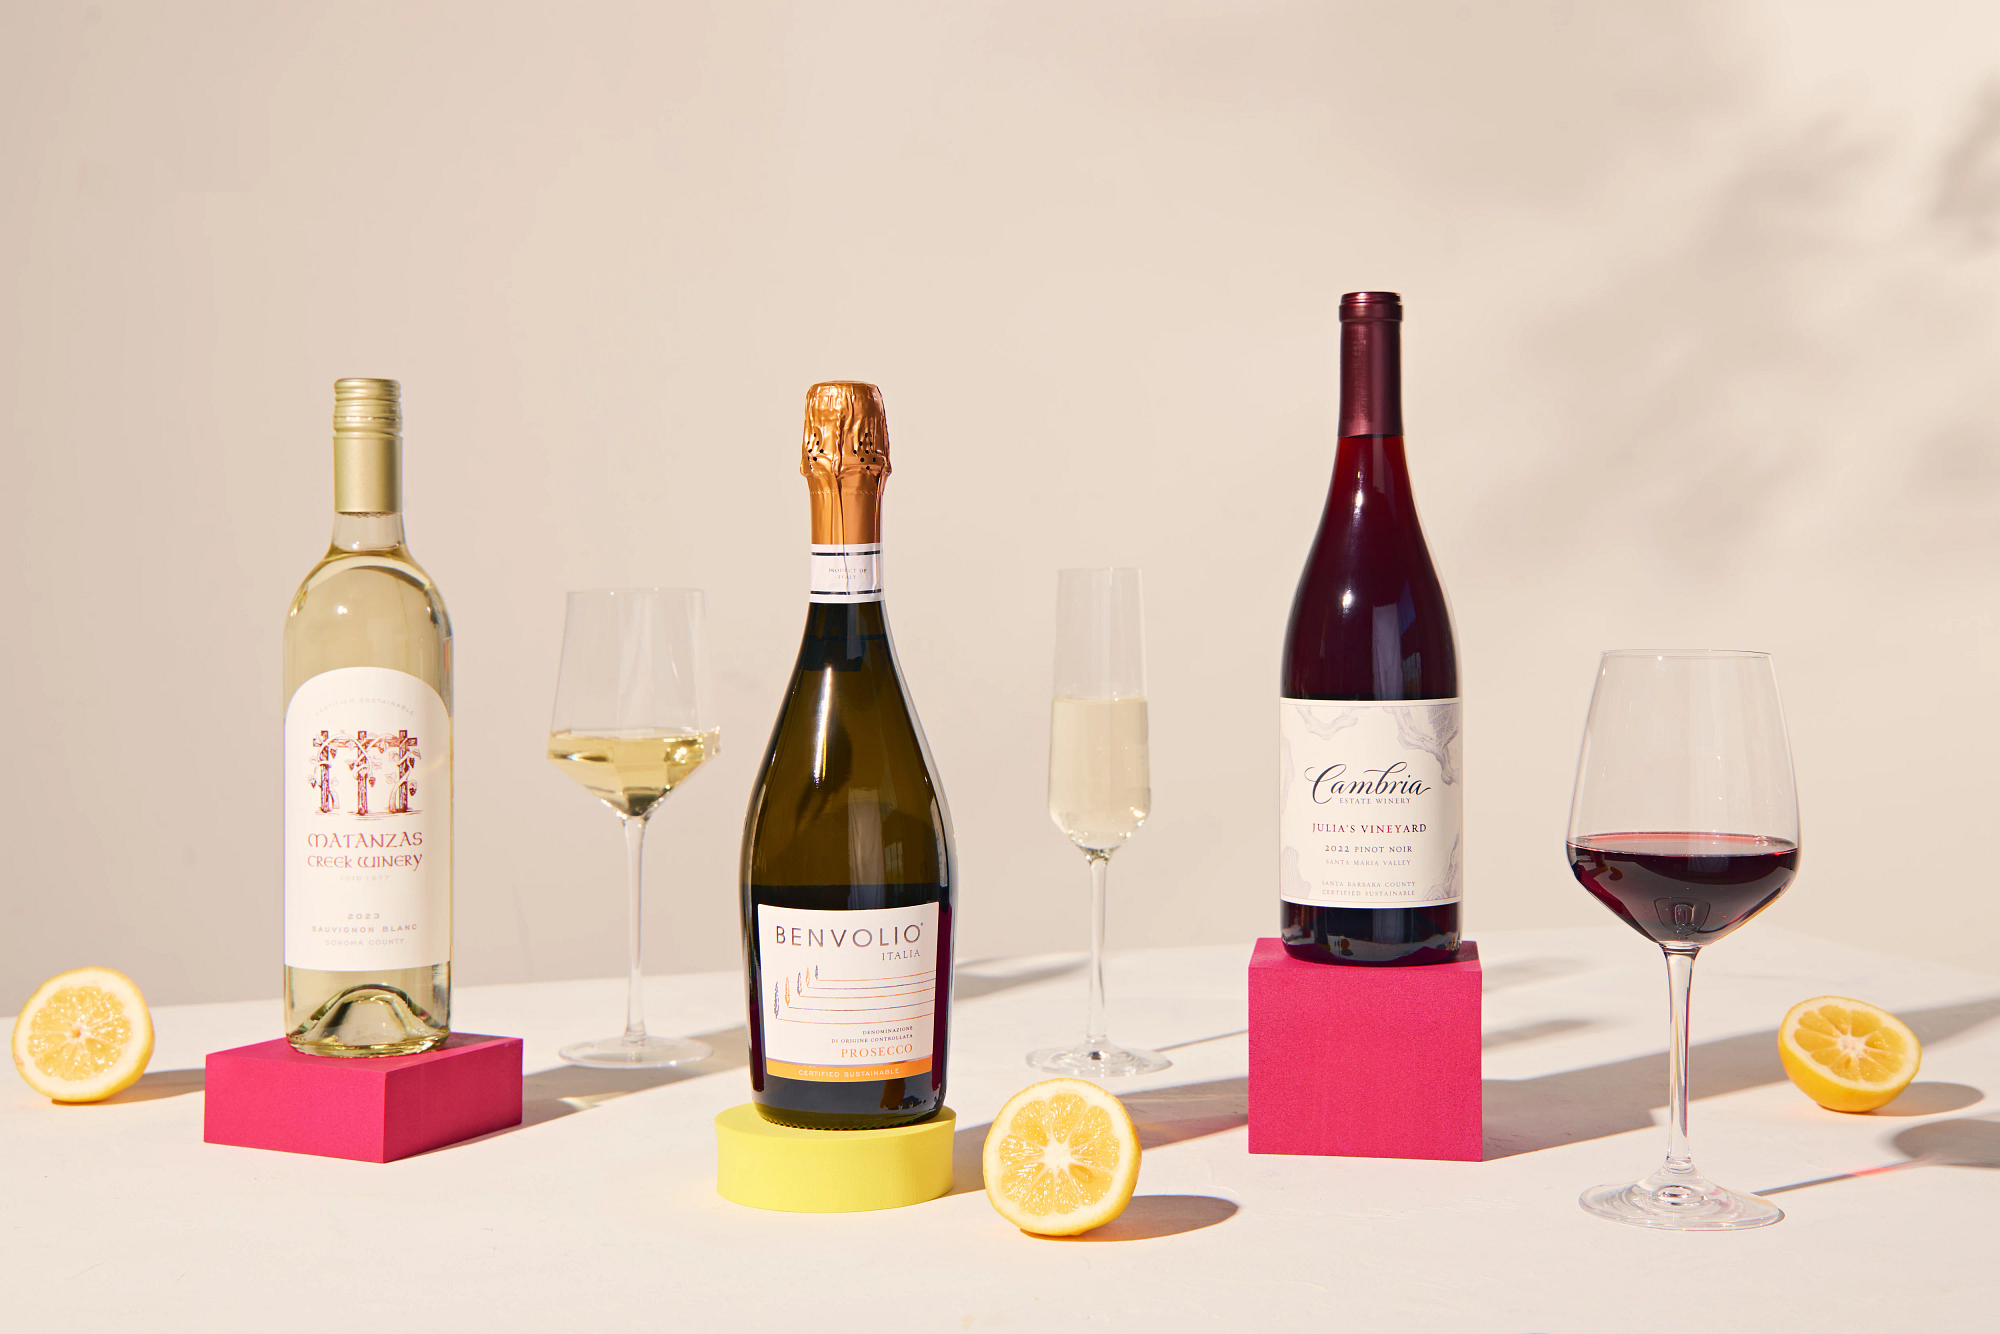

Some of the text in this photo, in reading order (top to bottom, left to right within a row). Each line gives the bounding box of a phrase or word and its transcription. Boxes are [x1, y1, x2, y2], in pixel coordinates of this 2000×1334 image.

[359, 697, 415, 716] SUSTAINABLE
[1304, 761, 1431, 804] Cambria
[1312, 823, 1427, 833] JULIA'S VINEYARD
[307, 831, 423, 848] MATANZAS
[307, 853, 423, 871] CREEK WINERY
[311, 923, 418, 933] SAUVIGNON BLANC
[776, 924, 921, 948] BENVOLIO
[882, 949, 921, 961] ITALIA
[862, 1025, 914, 1035] DENOMINAZIONE
[870, 1033, 914, 1043] CONTROLLATA
[841, 1043, 913, 1058] PROSECCO
[798, 1067, 900, 1078] CERTIFIED SUSTAINABLE
